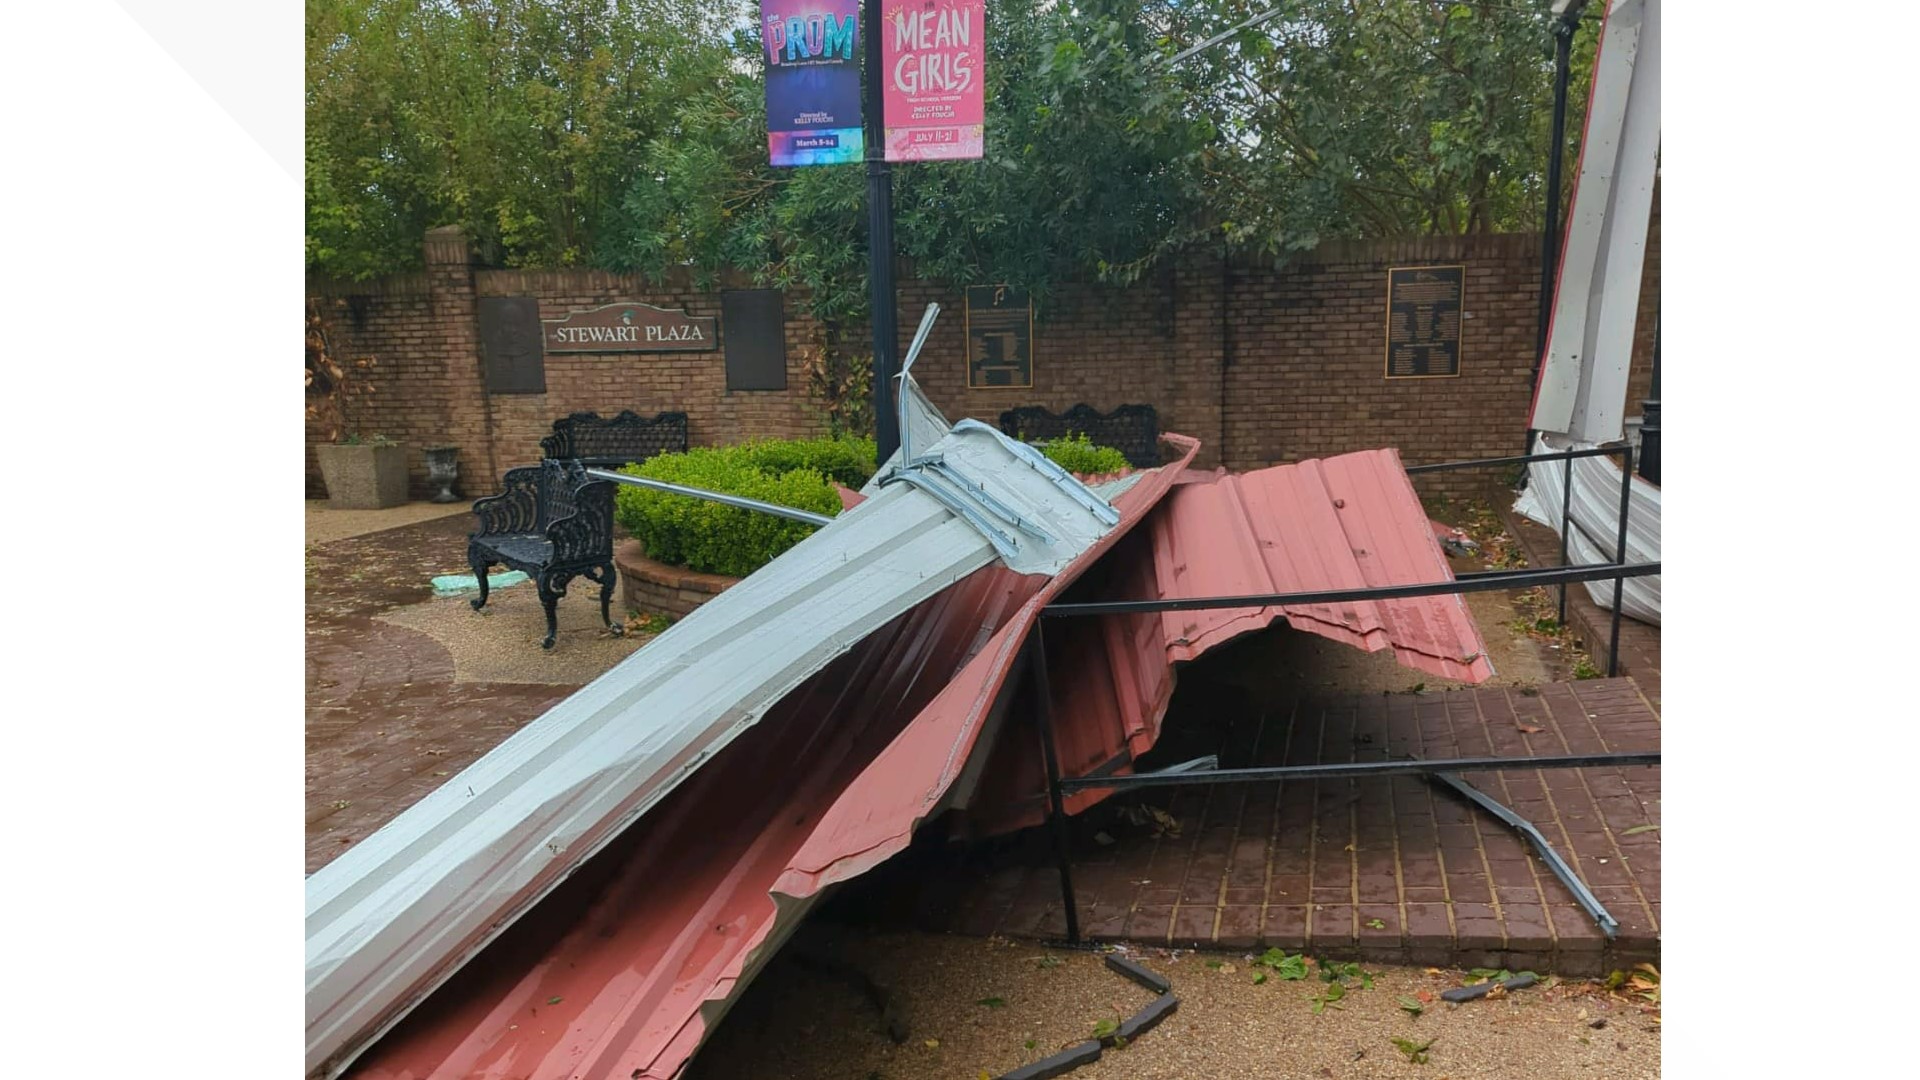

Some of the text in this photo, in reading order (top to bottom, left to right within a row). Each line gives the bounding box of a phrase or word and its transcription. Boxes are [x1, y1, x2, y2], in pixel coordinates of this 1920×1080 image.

[768, 12, 854, 65] PROM
[895, 7, 970, 53] MEAN
[894, 51, 971, 95] GIRLS
[913, 105, 942, 113] DIRECTED
[796, 139, 818, 147] March
[915, 131, 933, 142] JULY
[557, 325, 704, 343] STEWART PLAZA
